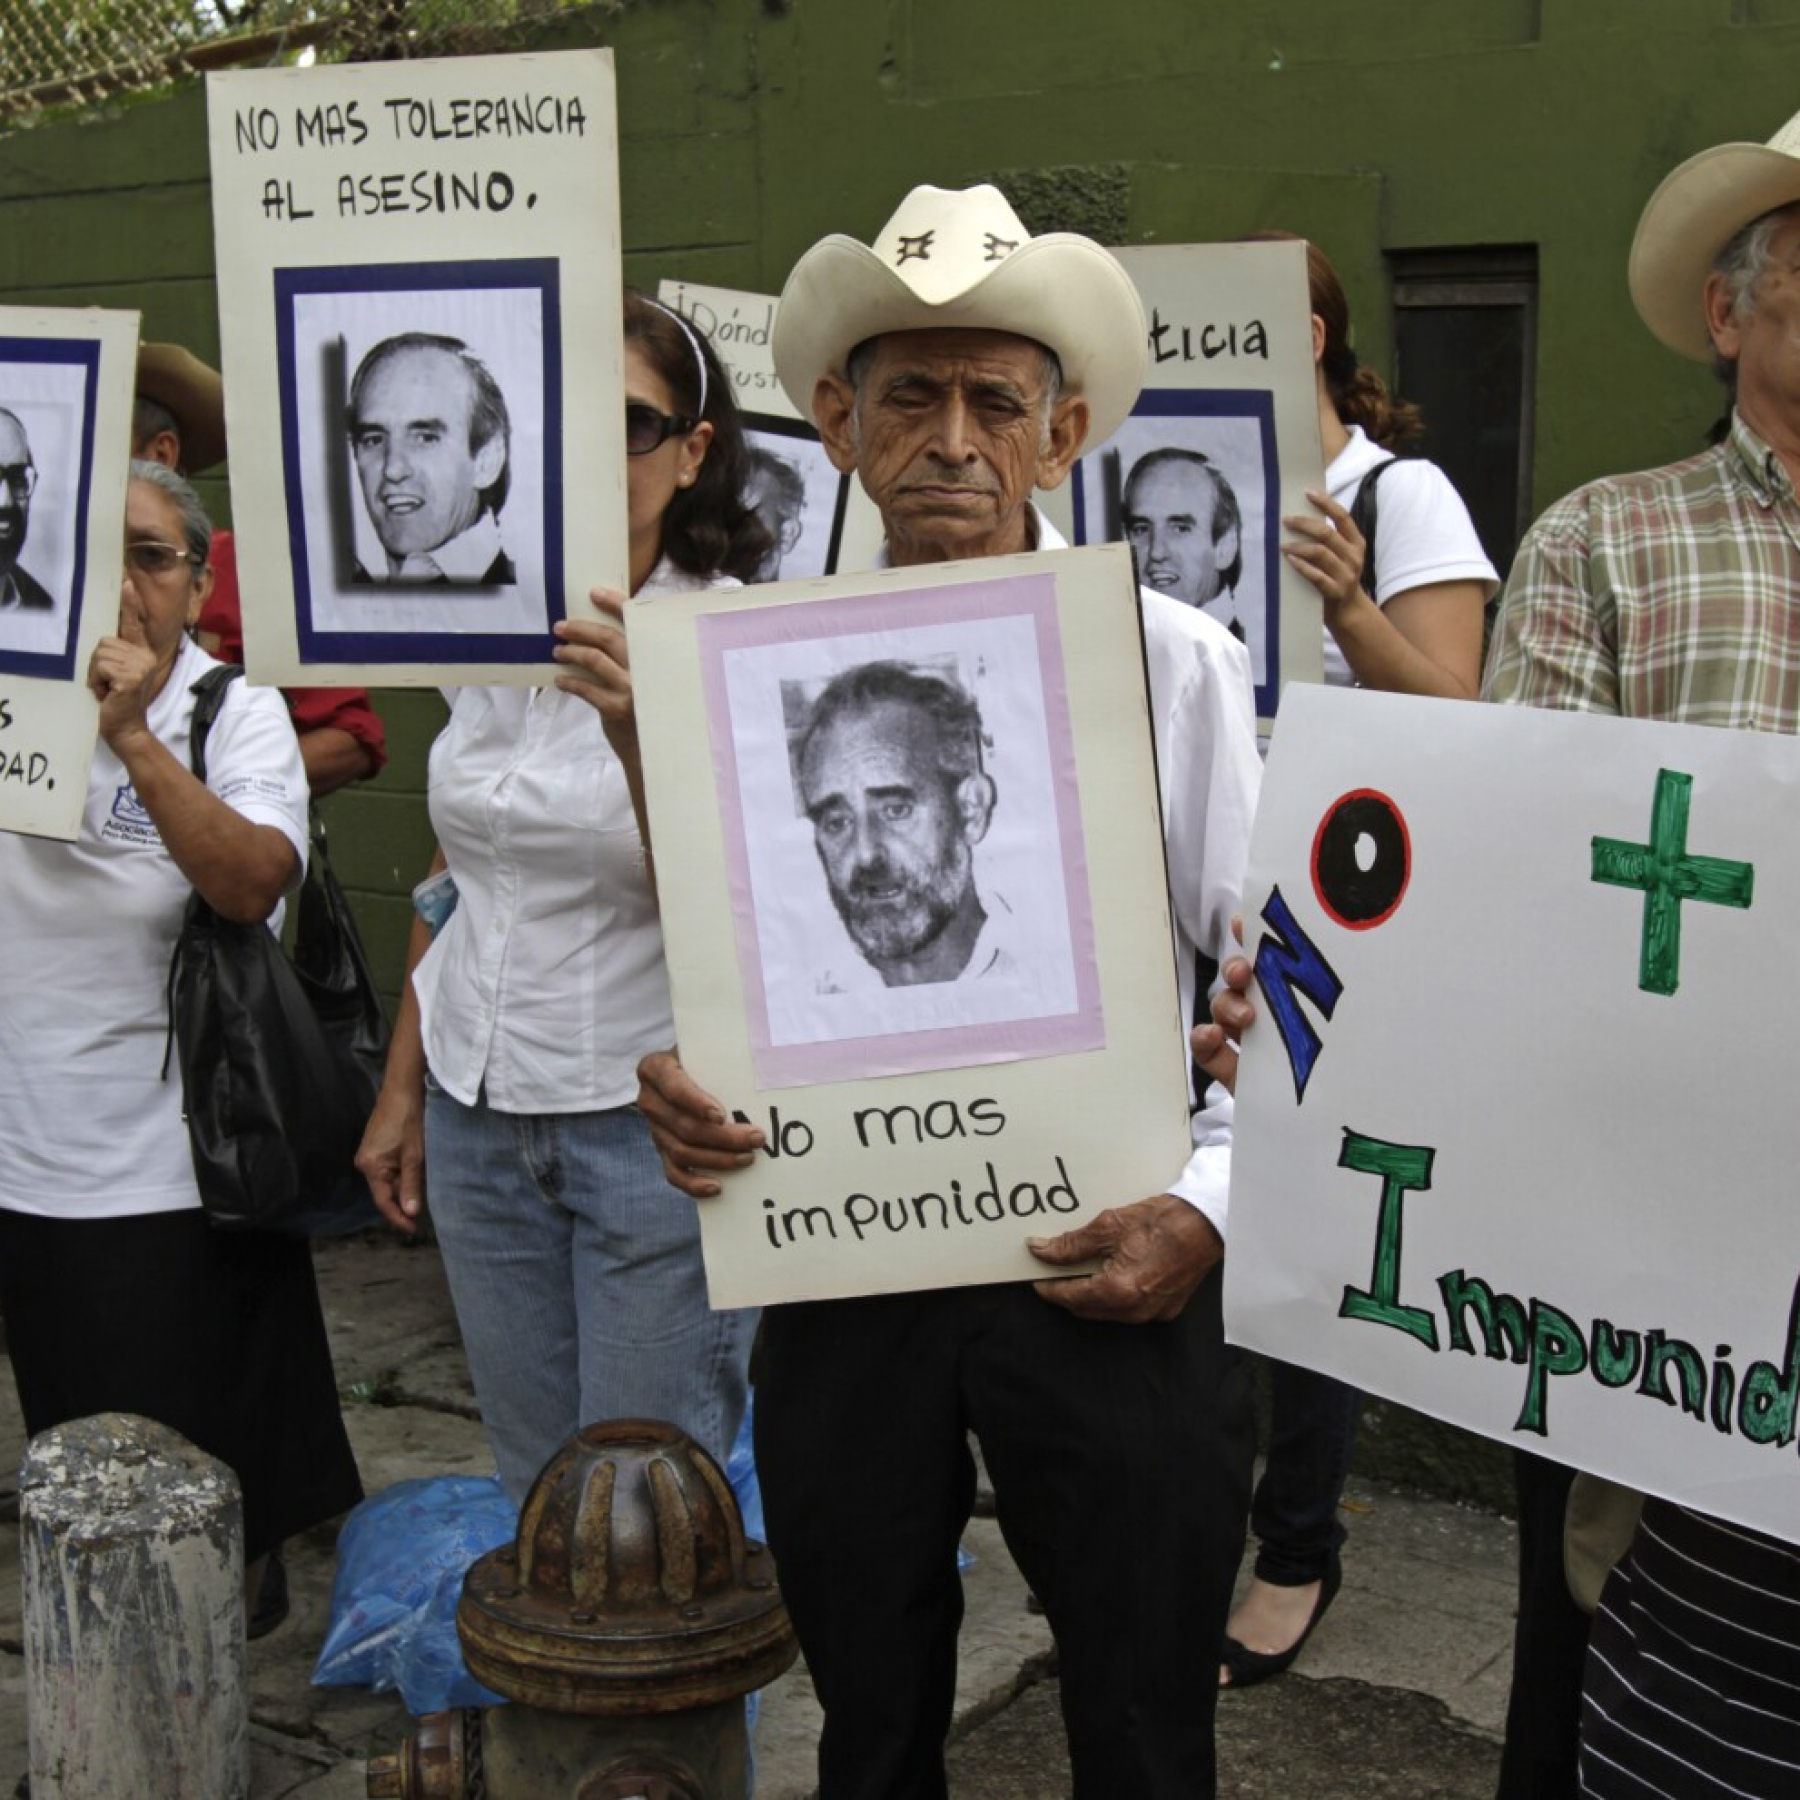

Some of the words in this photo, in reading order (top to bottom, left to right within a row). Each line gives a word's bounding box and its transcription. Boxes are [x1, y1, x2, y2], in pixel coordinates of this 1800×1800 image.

[236, 107, 279, 153] NO
[297, 101, 368, 146] MAS
[385, 93, 586, 139] TOLERANCIA
[262, 178, 314, 221] AL
[338, 170, 537, 216] ASESINO.
[1147, 306, 1269, 364] ticia
[732, 1105, 814, 1158] No
[853, 1097, 1006, 1148] mas
[762, 1154, 1080, 1249] impunidad
[1337, 1125, 1800, 1449] Impunid
